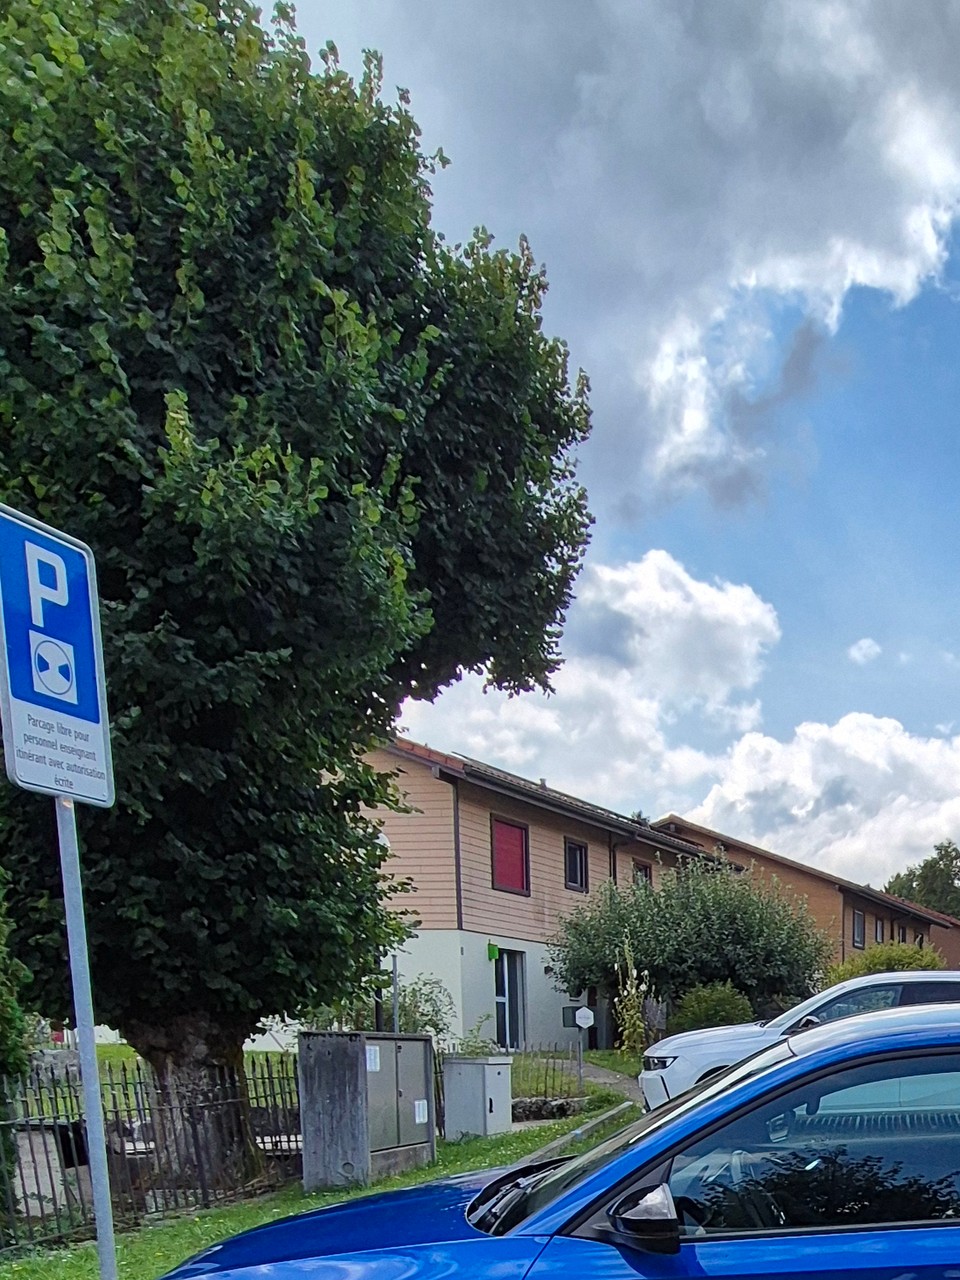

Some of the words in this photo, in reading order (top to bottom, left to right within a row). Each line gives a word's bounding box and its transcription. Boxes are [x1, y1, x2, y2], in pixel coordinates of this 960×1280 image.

[25, 540, 69, 627] P
[27, 713, 55, 734] Parcage
[56, 721, 72, 737] libre
[74, 730, 90, 742] pour
[23, 733, 58, 750] personnel
[59, 743, 97, 761] enseignant
[16, 746, 47, 765] itinérant
[48, 757, 65, 769] avec
[66, 761, 105, 780] autorisation
[54, 774, 74, 789] écrite
